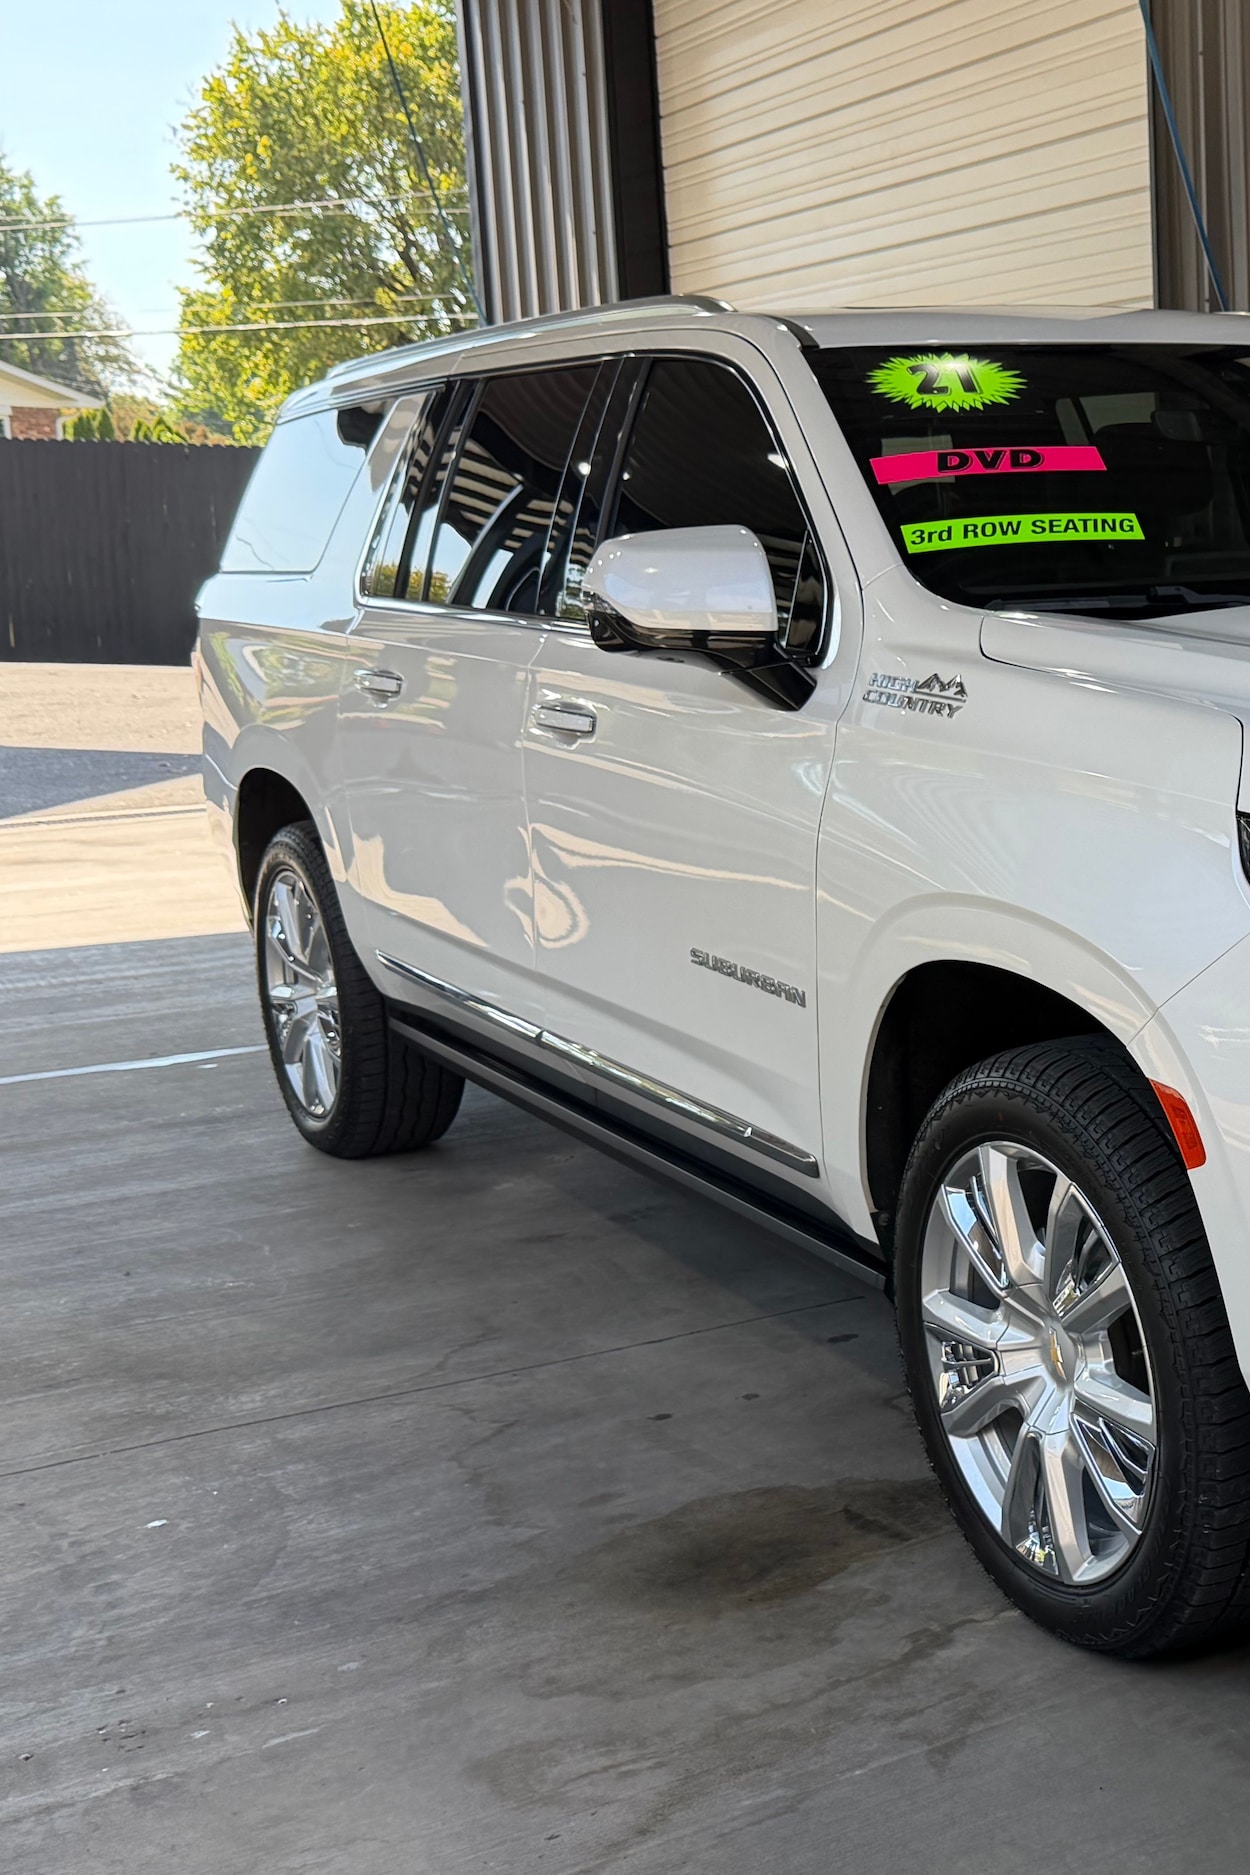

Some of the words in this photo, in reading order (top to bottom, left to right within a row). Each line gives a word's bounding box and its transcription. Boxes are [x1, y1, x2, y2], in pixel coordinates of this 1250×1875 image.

[908, 364, 983, 395] 21
[937, 449, 1044, 473] DVD
[910, 525, 952, 546] 3rd
[962, 520, 1022, 540] ROW
[1031, 517, 1135, 535] SEATING
[869, 673, 918, 693] HIGH
[862, 690, 963, 719] COUNTRY
[690, 947, 806, 1008] SUBURBAN
